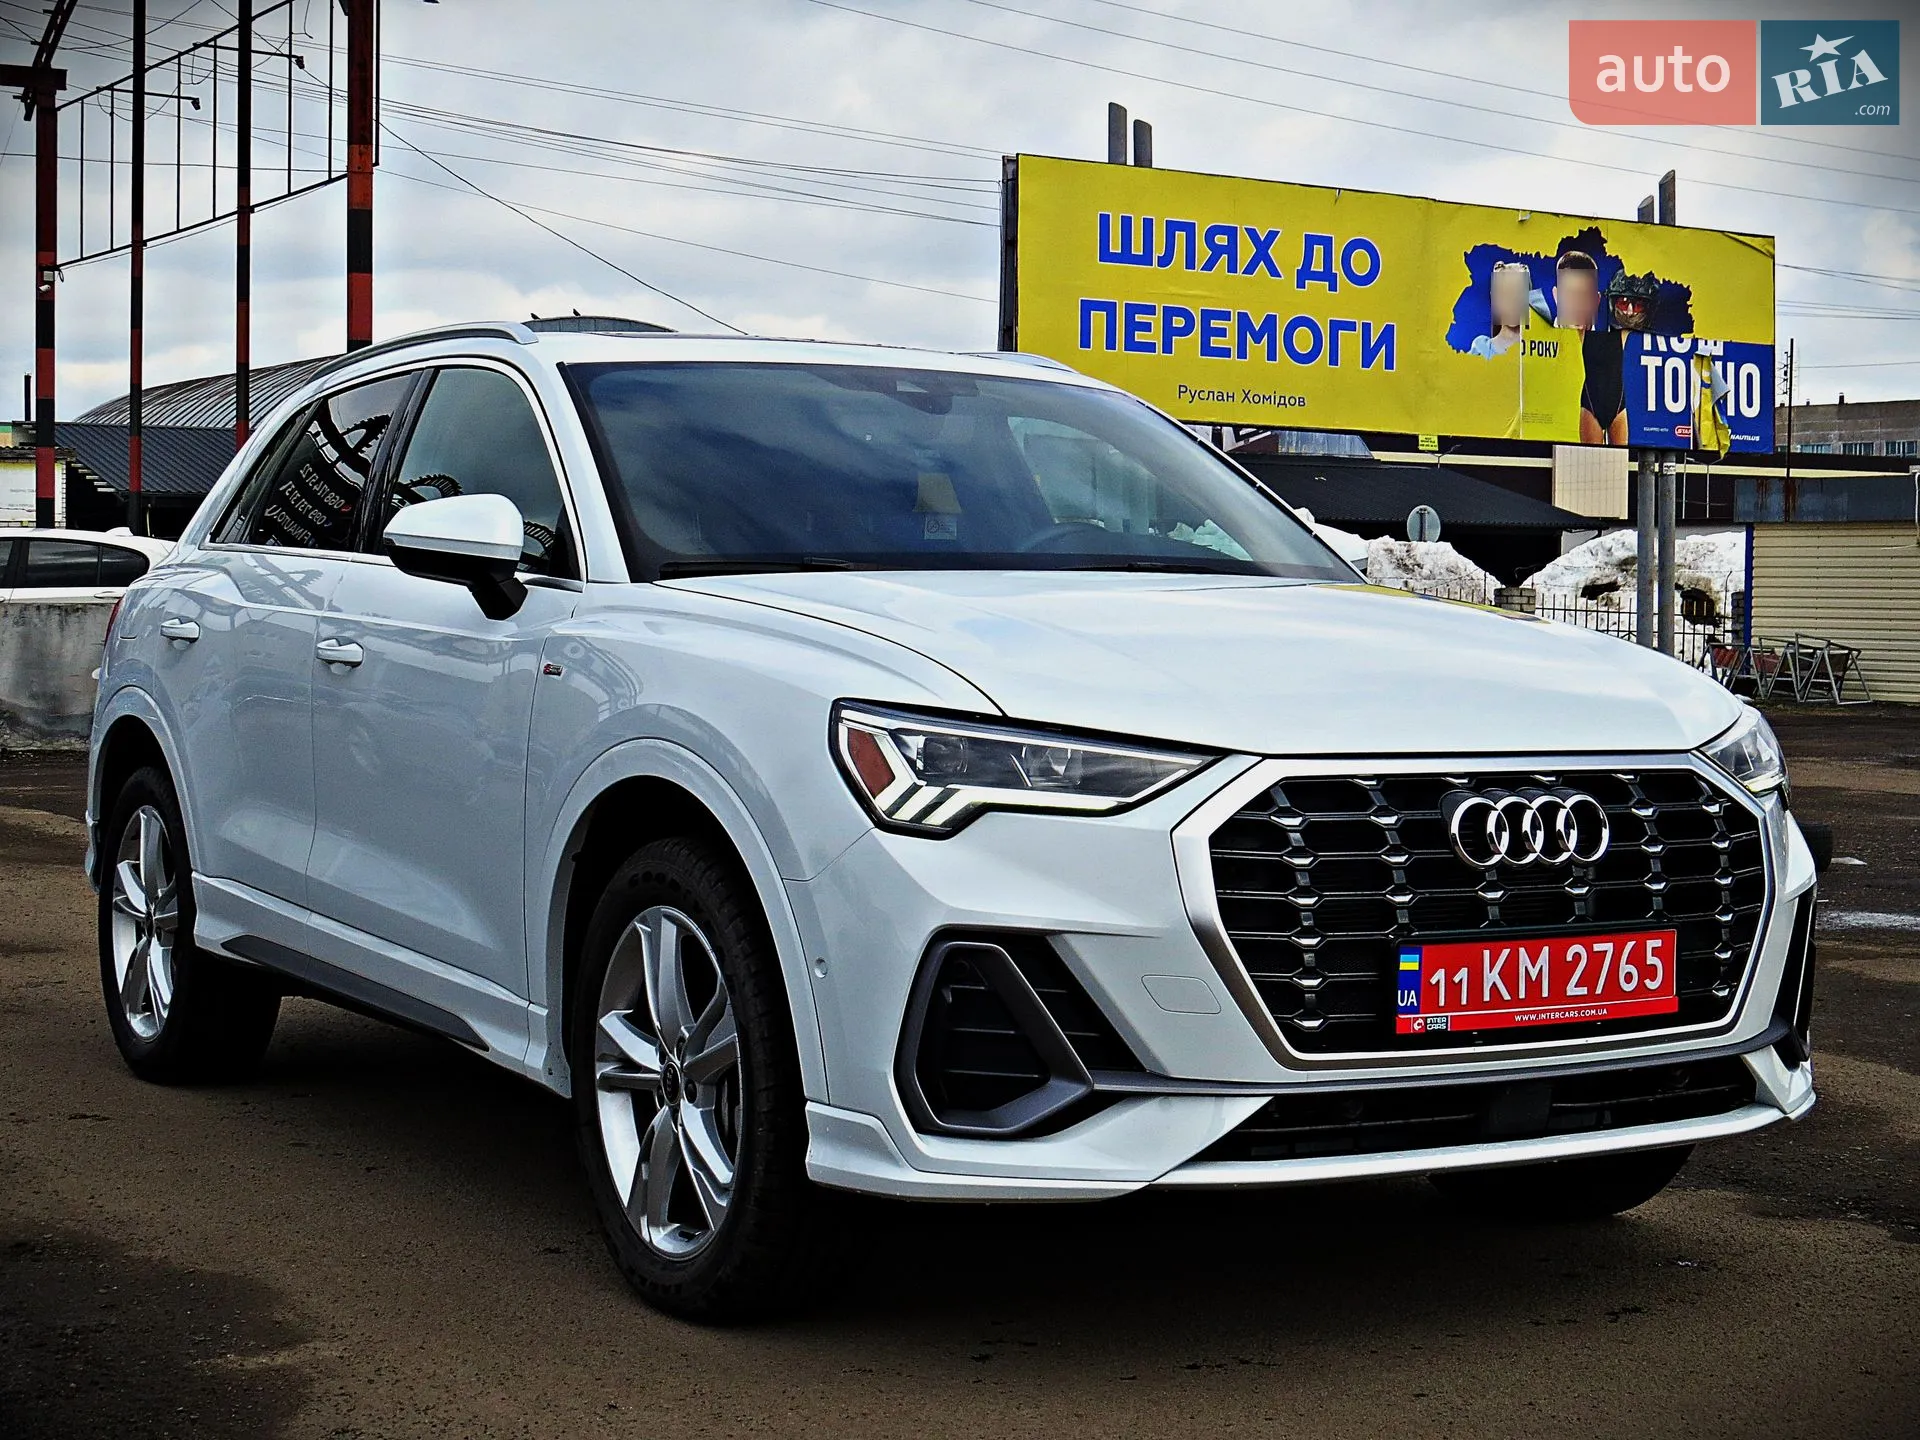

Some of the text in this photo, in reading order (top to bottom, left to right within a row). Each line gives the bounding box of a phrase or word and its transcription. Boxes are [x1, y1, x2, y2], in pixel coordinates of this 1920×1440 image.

[1098, 211, 1382, 293] ШЛЯХ ДО
[1078, 297, 1397, 371] ПЕРЕМОГИ
[1530, 340, 1558, 358] РОКУ
[1178, 384, 1306, 408] Руслан Хомідов
[1640, 355, 1761, 418] ТОНО
[1430, 939, 1664, 1007] 11 KM 2765
[1397, 990, 1417, 1007] UA
[1514, 1007, 1608, 1022] WWW.INTERCARS.COM.UA
